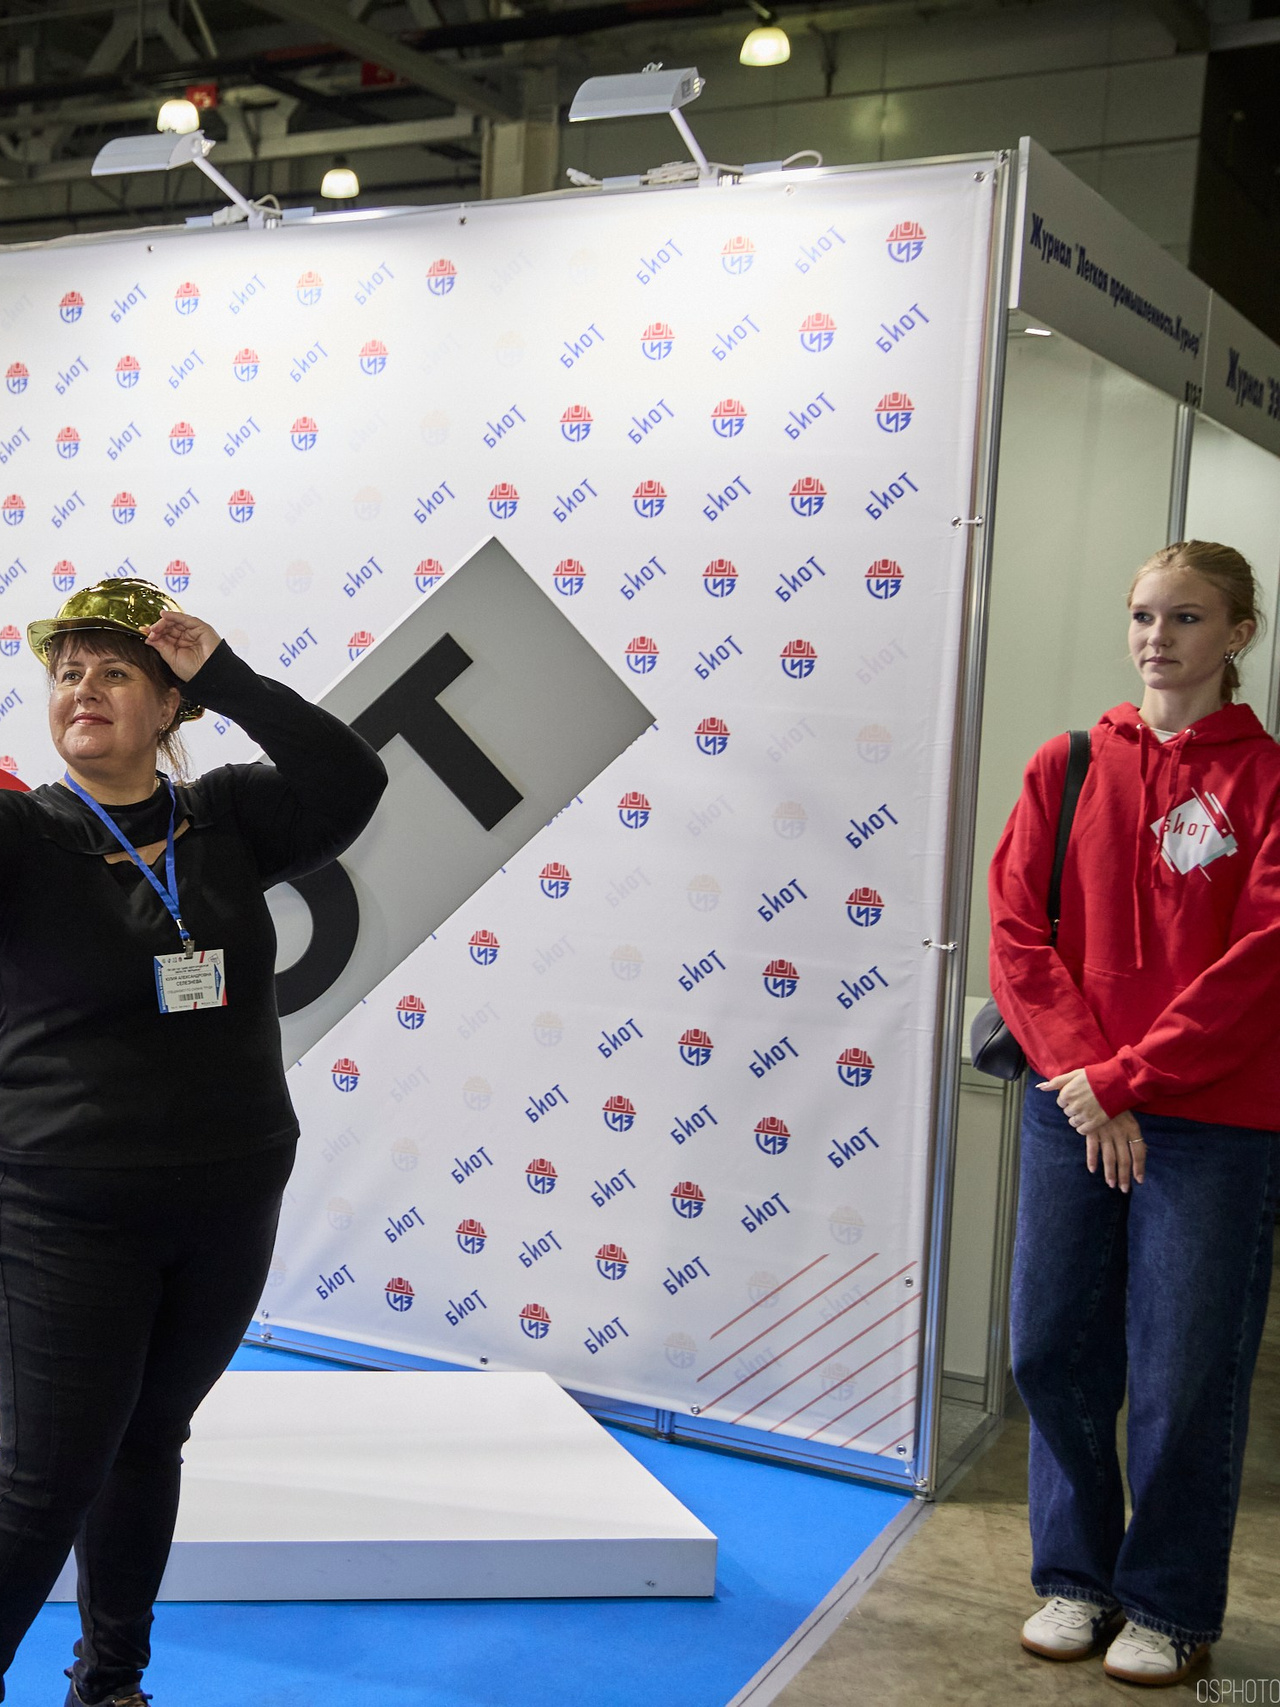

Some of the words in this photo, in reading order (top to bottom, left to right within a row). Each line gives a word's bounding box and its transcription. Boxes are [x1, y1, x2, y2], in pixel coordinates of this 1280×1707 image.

[1030, 213, 1072, 269] Журнал
[559, 324, 604, 369] БИОТ
[711, 314, 760, 362] БИОТ
[875, 304, 929, 353] БИОТ
[168, 349, 204, 390] БИОТ
[483, 405, 526, 448] БИОТ
[627, 399, 674, 445] БИОТ
[784, 392, 835, 440] БИОТ
[414, 481, 455, 524] БИОТ
[553, 479, 597, 523] БИОТ
[703, 476, 751, 522] БИОТ
[865, 473, 918, 520] БИОТ
[343, 557, 383, 598] БИОТ
[620, 556, 666, 600] БИОТ
[775, 556, 826, 602] БИОТ
[279, 628, 317, 668] БИОТ
[694, 636, 741, 680] БИОТ
[845, 804, 898, 849] БИОТ
[757, 879, 807, 922] БИОТ
[678, 950, 726, 992] БИОТ
[836, 966, 888, 1009] БИОТ
[597, 1018, 643, 1059] БИОТ
[748, 1037, 798, 1078] БИОТ
[525, 1084, 569, 1123] БИОТ
[670, 1105, 718, 1145] БИОТ
[451, 1147, 493, 1184] БИОТ
[827, 1126, 879, 1168] БИОТ
[591, 1168, 635, 1207] БИОТ
[385, 1206, 424, 1243] БИОТ
[740, 1192, 789, 1233] БИОТ
[518, 1230, 561, 1268] БИОТ
[662, 1256, 711, 1295] БИОТ
[444, 1290, 486, 1326] БИОТ
[584, 1317, 629, 1354] БИОТ
